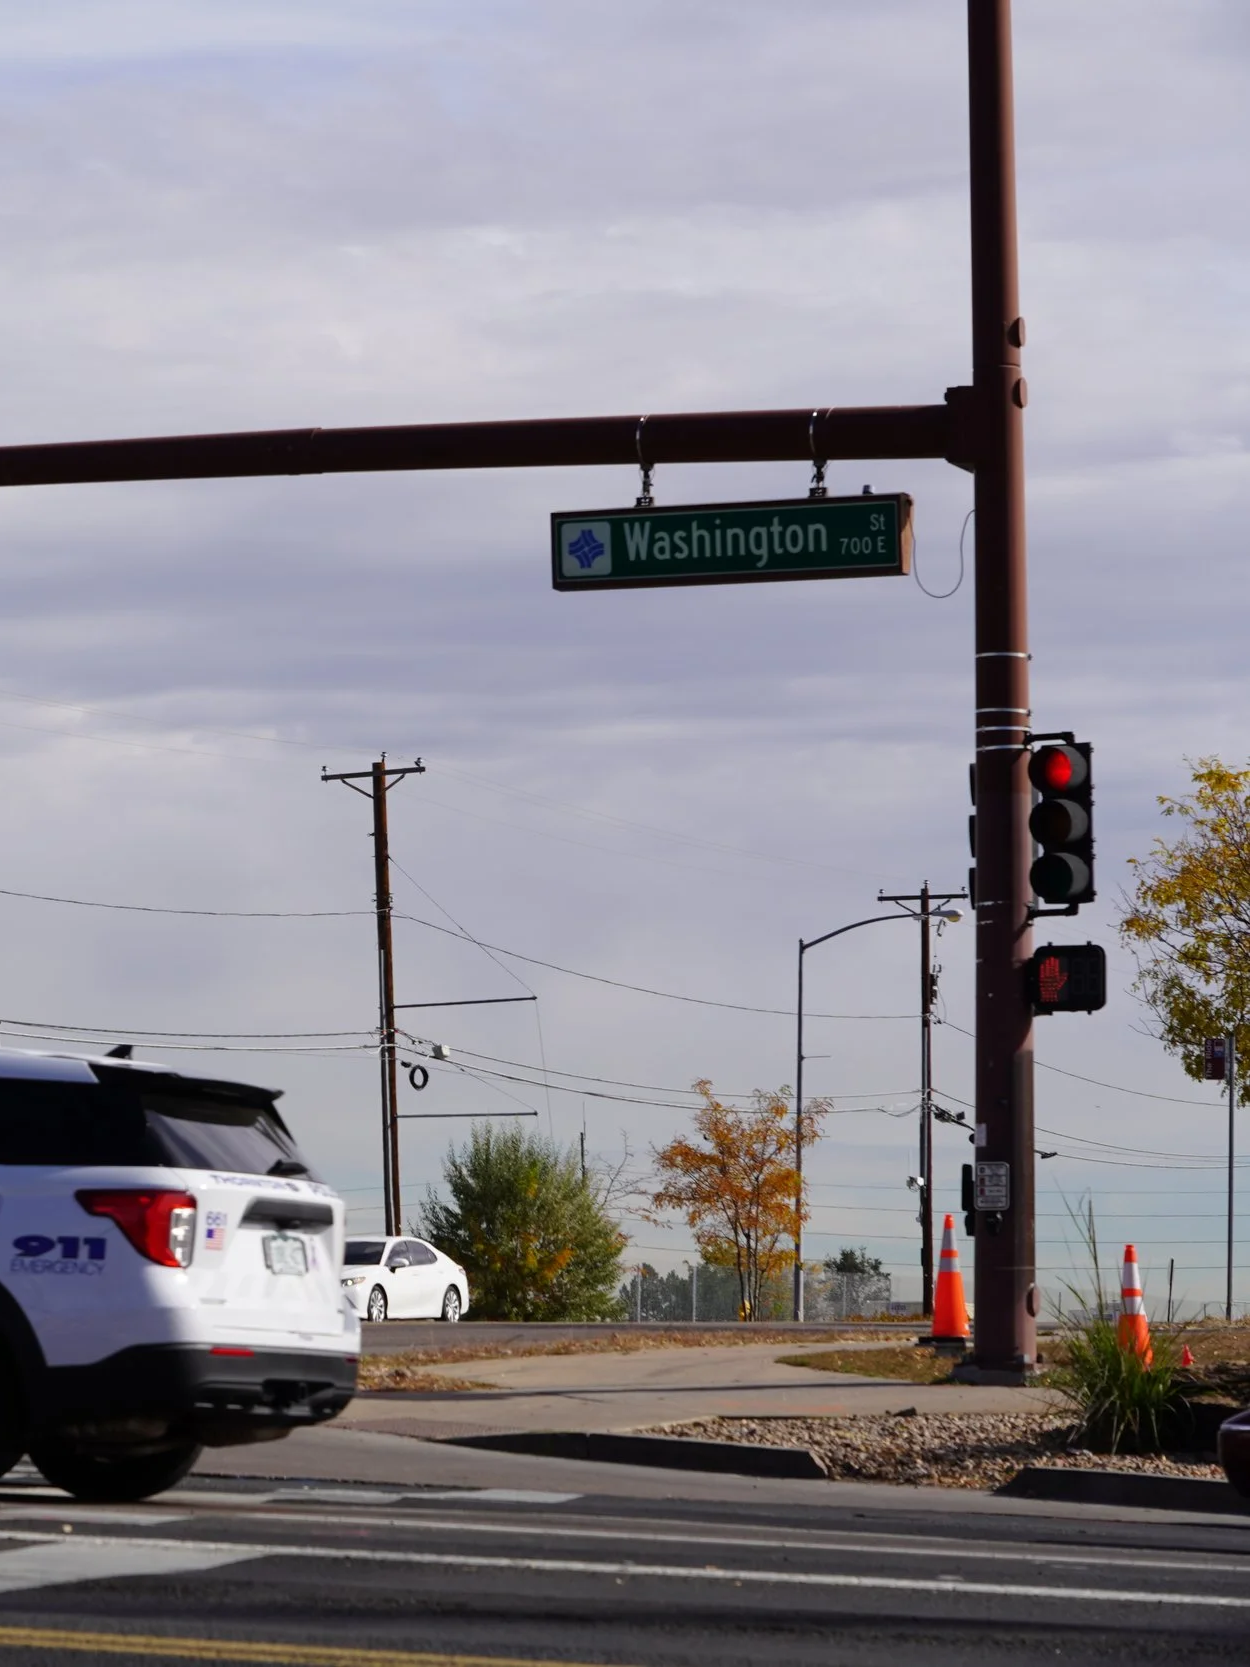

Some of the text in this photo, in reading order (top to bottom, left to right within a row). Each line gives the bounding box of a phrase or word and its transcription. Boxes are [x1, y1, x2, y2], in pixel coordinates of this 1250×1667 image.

[870, 513, 886, 531] St
[623, 516, 828, 568] Washington
[839, 536, 887, 555] 700 E
[12, 1234, 107, 1260] 911
[10, 1258, 105, 1276] EMERGENCY
